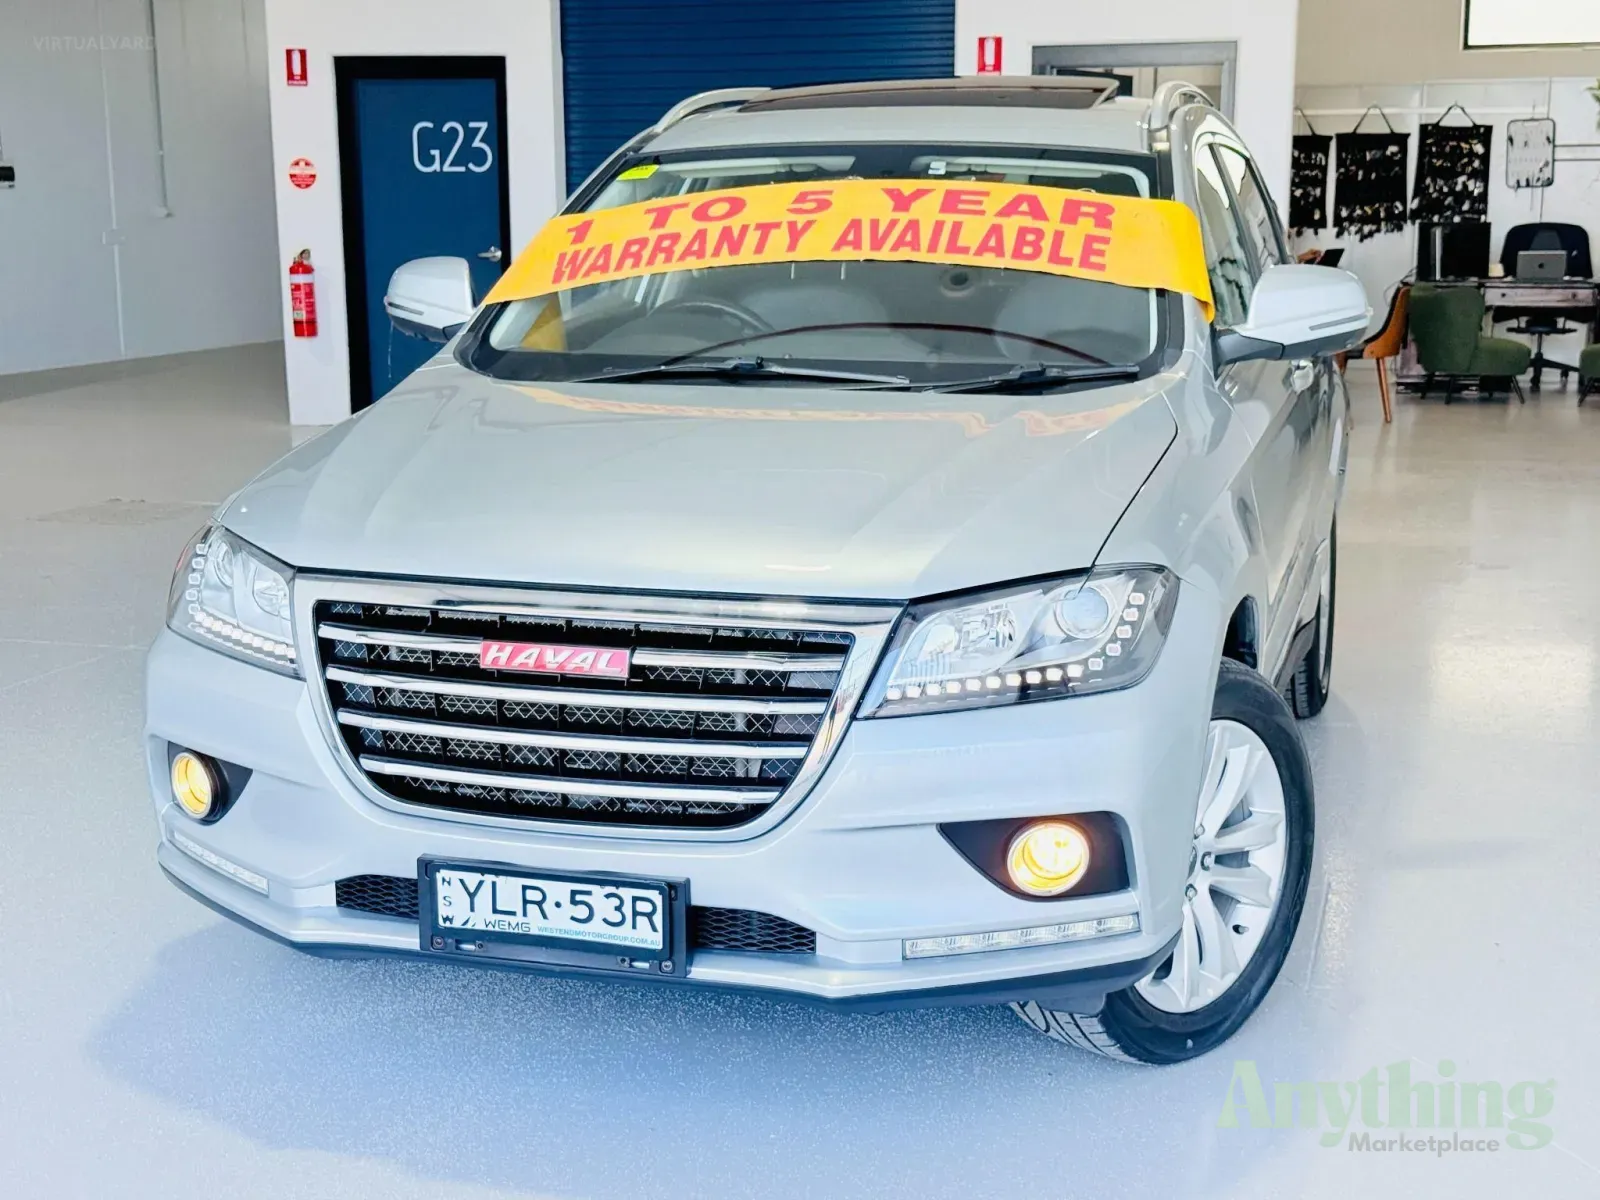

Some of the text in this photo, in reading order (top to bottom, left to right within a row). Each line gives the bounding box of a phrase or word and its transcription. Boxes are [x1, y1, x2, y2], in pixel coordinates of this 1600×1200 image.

[412, 121, 493, 173] G23
[567, 187, 1116, 246] 1 TO 5 YEAR
[551, 218, 1111, 285] WARRANTY AVAILABLE
[484, 644, 624, 674] HAVAL
[483, 918, 532, 933] WEMG
[537, 925, 661, 947] WESTENDMOTORGROUP.COM.AU
